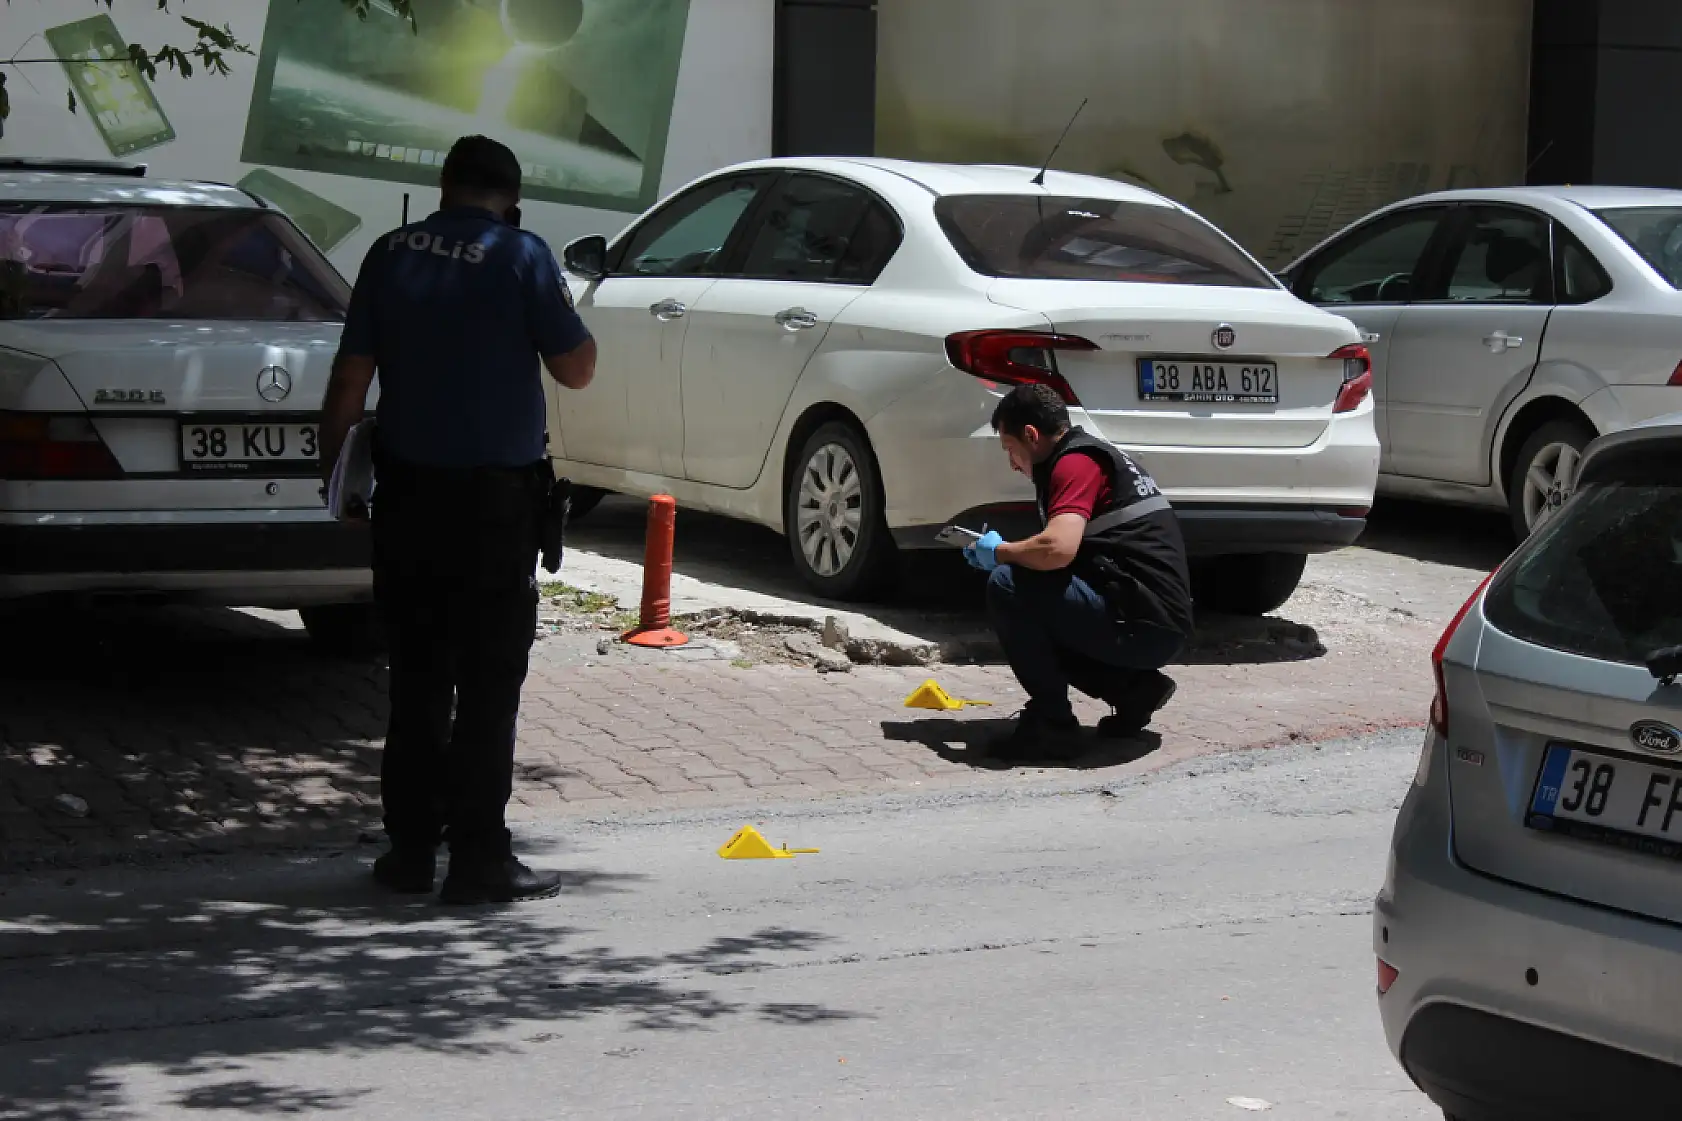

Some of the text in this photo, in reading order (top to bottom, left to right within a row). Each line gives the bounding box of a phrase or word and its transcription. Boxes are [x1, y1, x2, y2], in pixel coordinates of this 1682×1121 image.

[1155, 365, 1271, 393] 38 ABA 612
[191, 427, 228, 458] 38
[242, 427, 286, 457] KU
[1639, 728, 1671, 748] Ford
[1541, 785, 1558, 801] TR
[1562, 759, 1616, 816] 38
